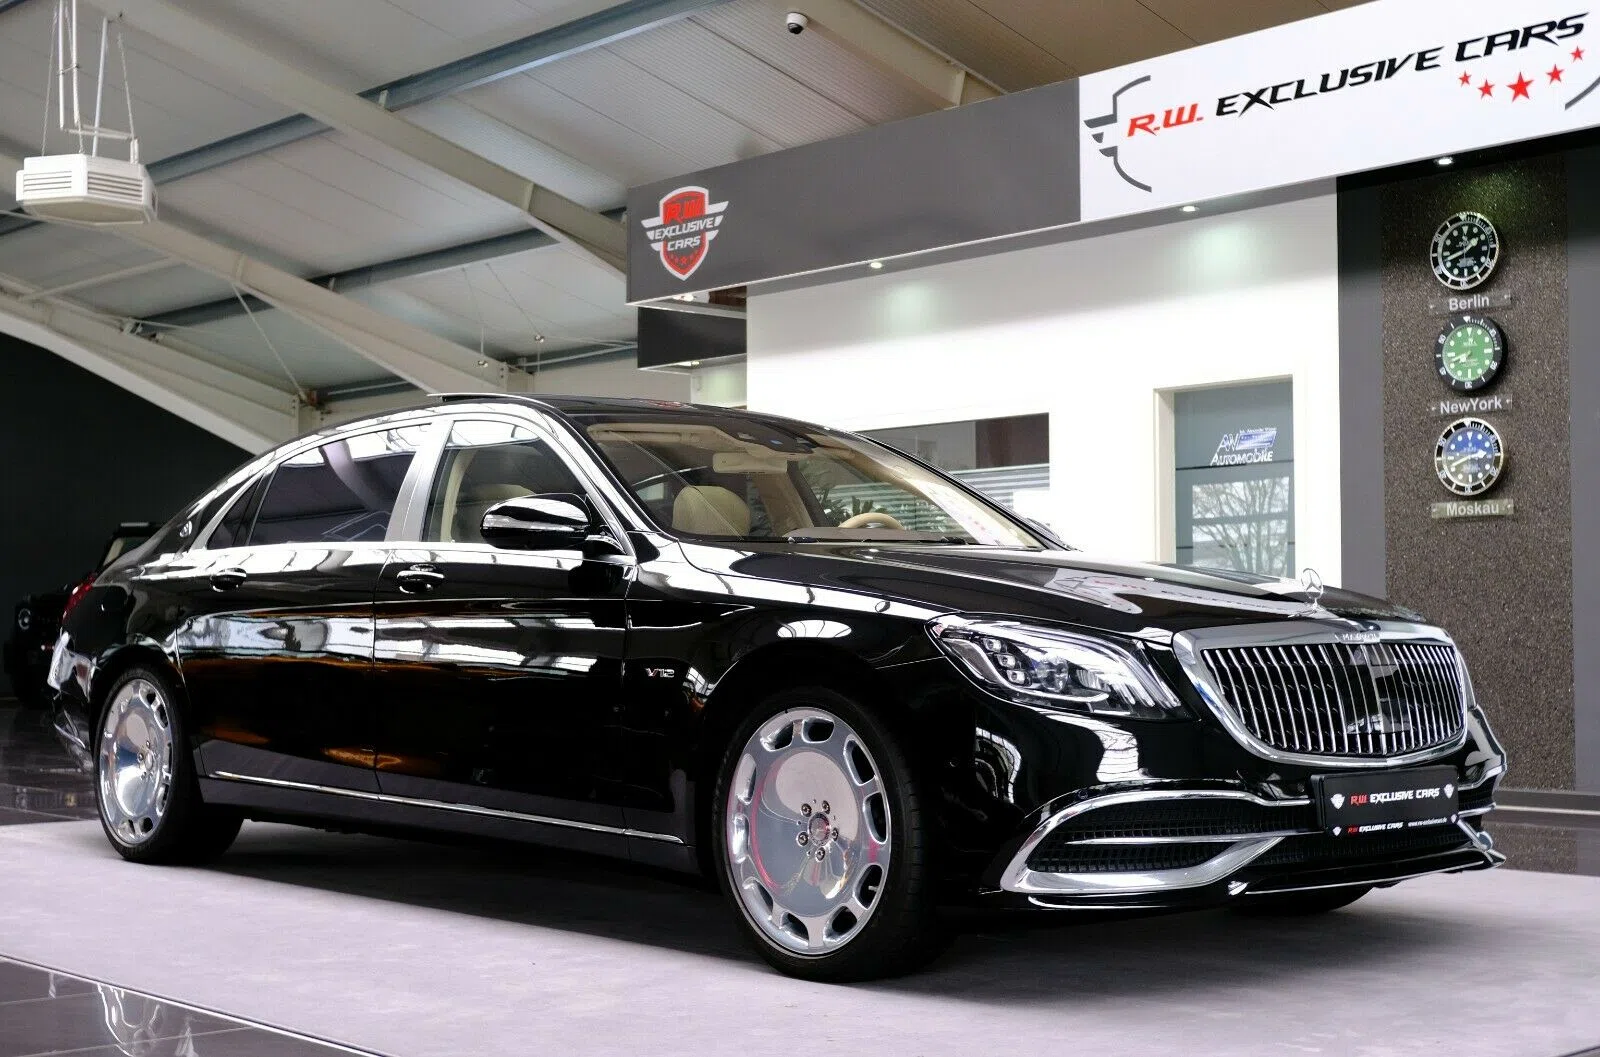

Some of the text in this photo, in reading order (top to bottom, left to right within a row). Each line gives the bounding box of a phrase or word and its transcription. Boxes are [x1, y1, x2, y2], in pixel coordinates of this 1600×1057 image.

[1127, 12, 1590, 137] R.W. EXCLUSIVE CARS
[654, 217, 714, 241] EXCLUSIVE
[667, 235, 701, 252] CARS
[1449, 294, 1490, 310] Berlin
[1440, 397, 1502, 413] NewYork
[1446, 502, 1499, 517] Moskau
[645, 667, 675, 678] V12
[1369, 789, 1414, 804] EXCLUSIVE
[1416, 787, 1440, 800] CARS
[1358, 823, 1386, 833] EXCLUSIVE
[1387, 821, 1404, 830] CARS
